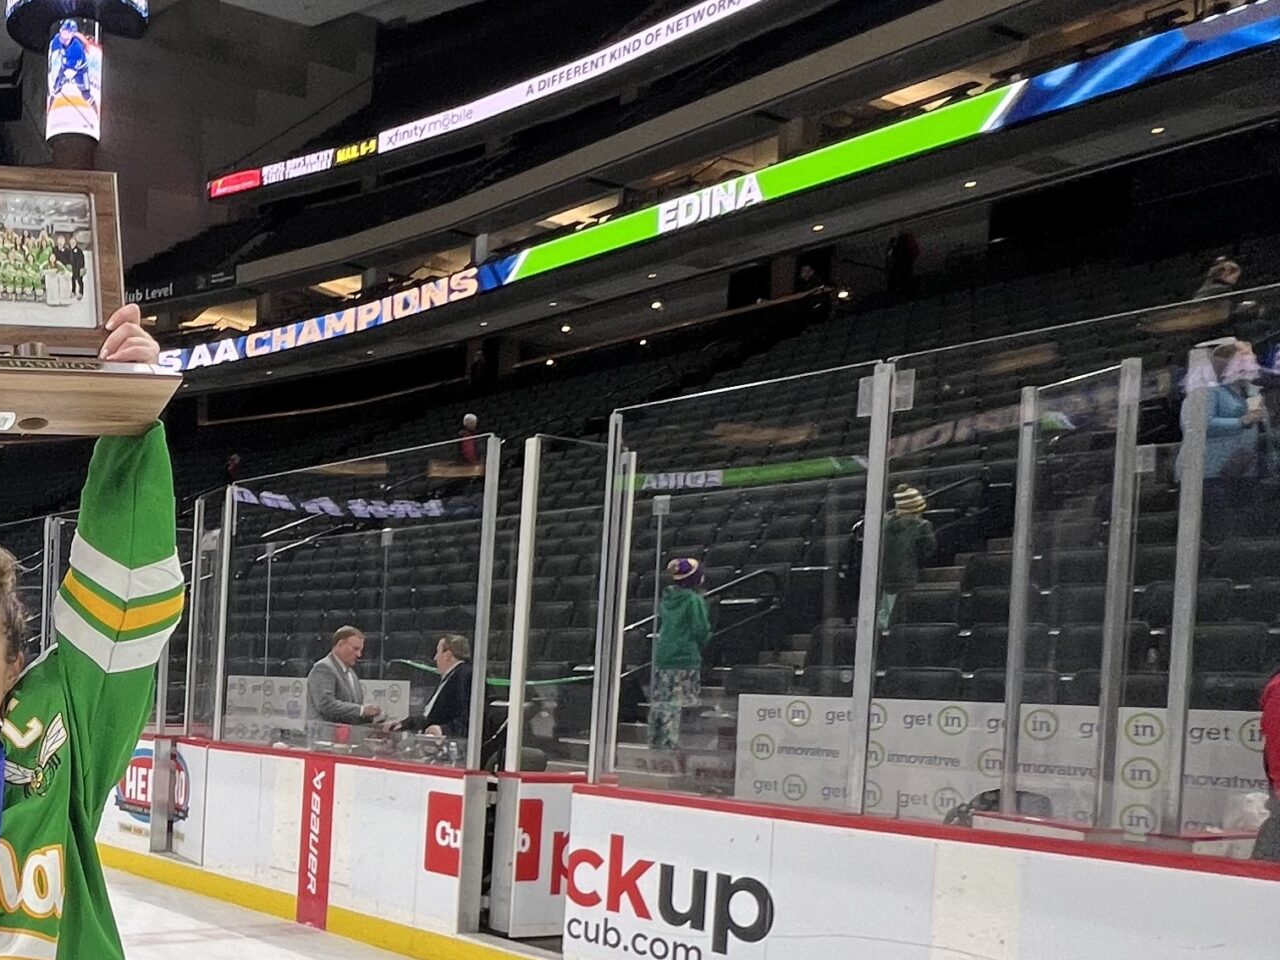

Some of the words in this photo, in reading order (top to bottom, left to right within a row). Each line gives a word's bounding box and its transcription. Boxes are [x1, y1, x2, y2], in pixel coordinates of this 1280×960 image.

[525, 84, 536, 97] A
[537, 54, 608, 92] DIFFERENT
[609, 39, 642, 63] KIND
[644, 28, 663, 46] OF
[387, 124, 427, 146] xfinity
[658, 174, 763, 235] EDINA
[125, 288, 143, 303] lub
[145, 281, 173, 300] Level
[186, 338, 239, 371] AA
[245, 267, 480, 358] CHAMPIONS
[756, 707, 782, 722] get
[825, 709, 854, 725] get
[903, 712, 933, 729] get
[943, 712, 962, 728] in
[1031, 715, 1051, 733] in
[1133, 719, 1156, 738] in
[1189, 725, 1232, 745] get
[1129, 764, 1153, 782] in
[306, 792, 322, 895] BAUER
